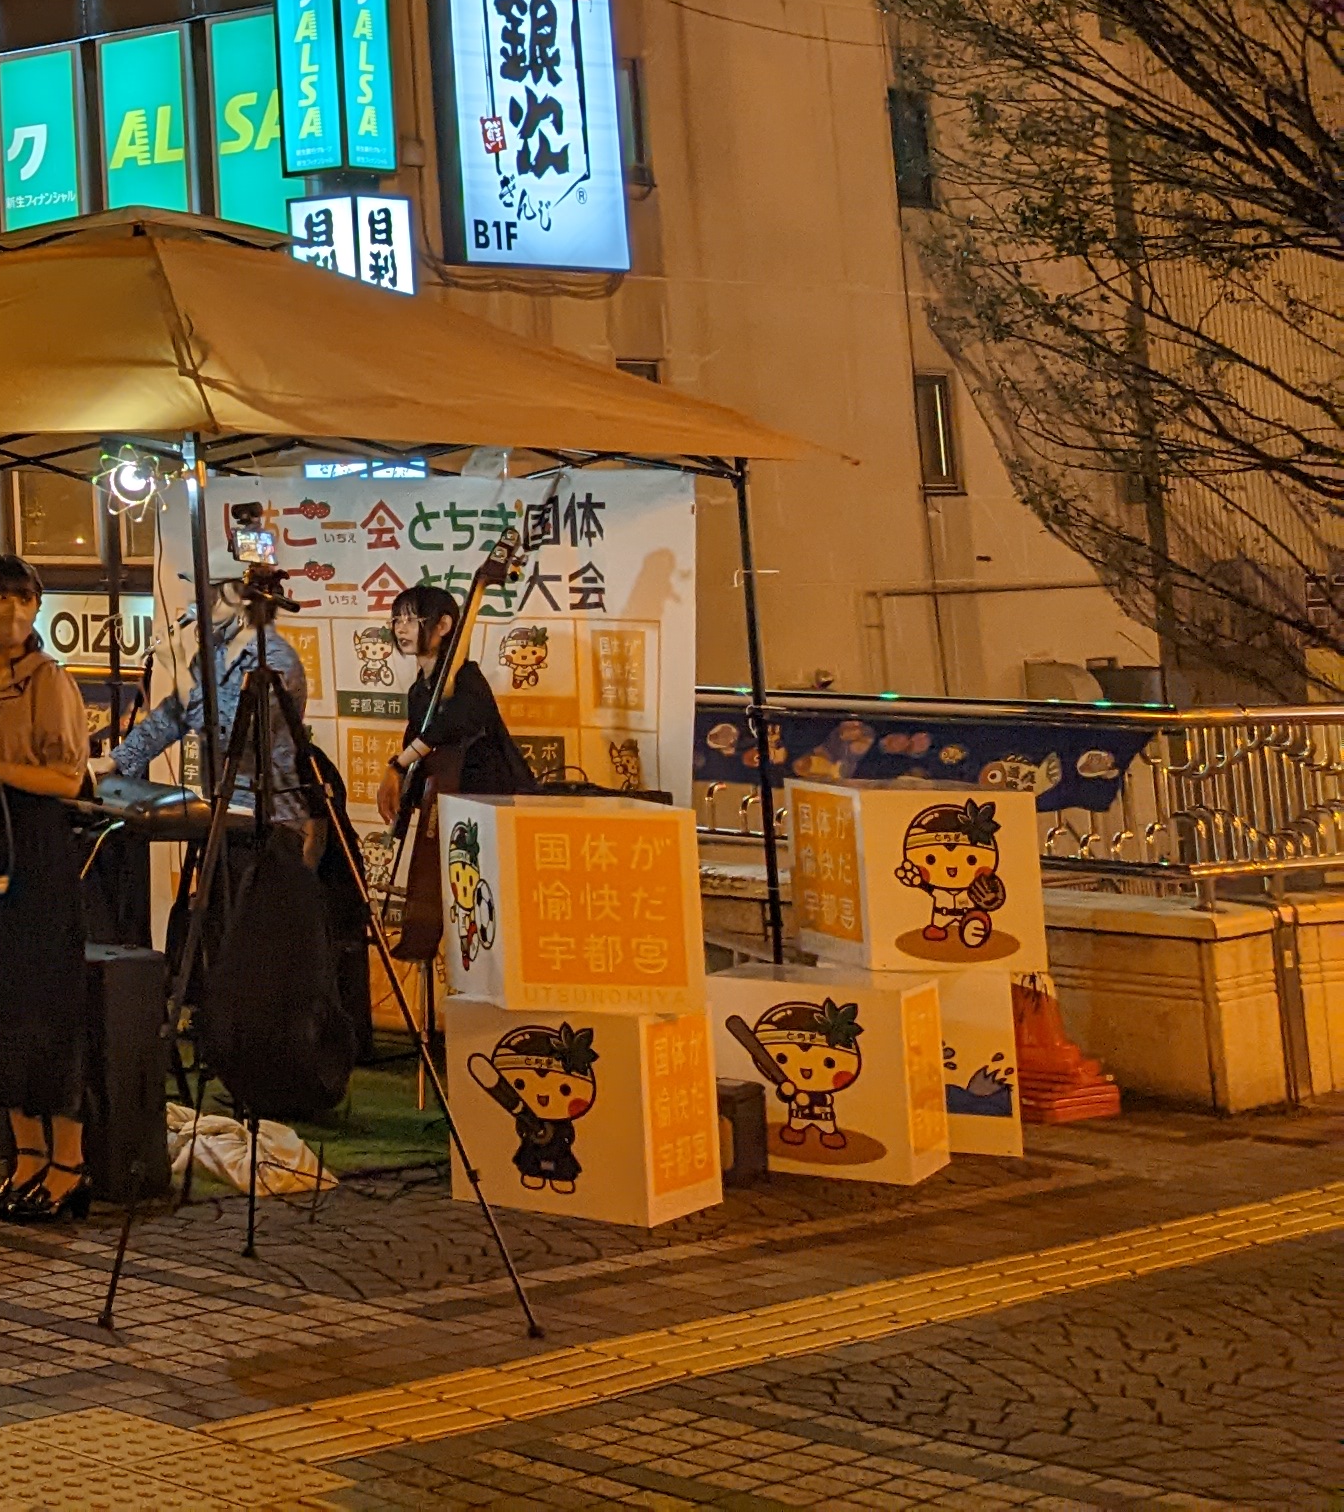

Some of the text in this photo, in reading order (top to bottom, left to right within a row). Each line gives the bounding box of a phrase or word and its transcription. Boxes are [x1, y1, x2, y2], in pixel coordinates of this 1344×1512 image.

[498, 174, 554, 233] ぎんじ
[473, 218, 518, 250] B1F
[50, 611, 153, 656] OIZU
[533, 832, 672, 873] 国体が
[532, 880, 668, 922] 愉快だ
[538, 933, 670, 975] 宇都宮
